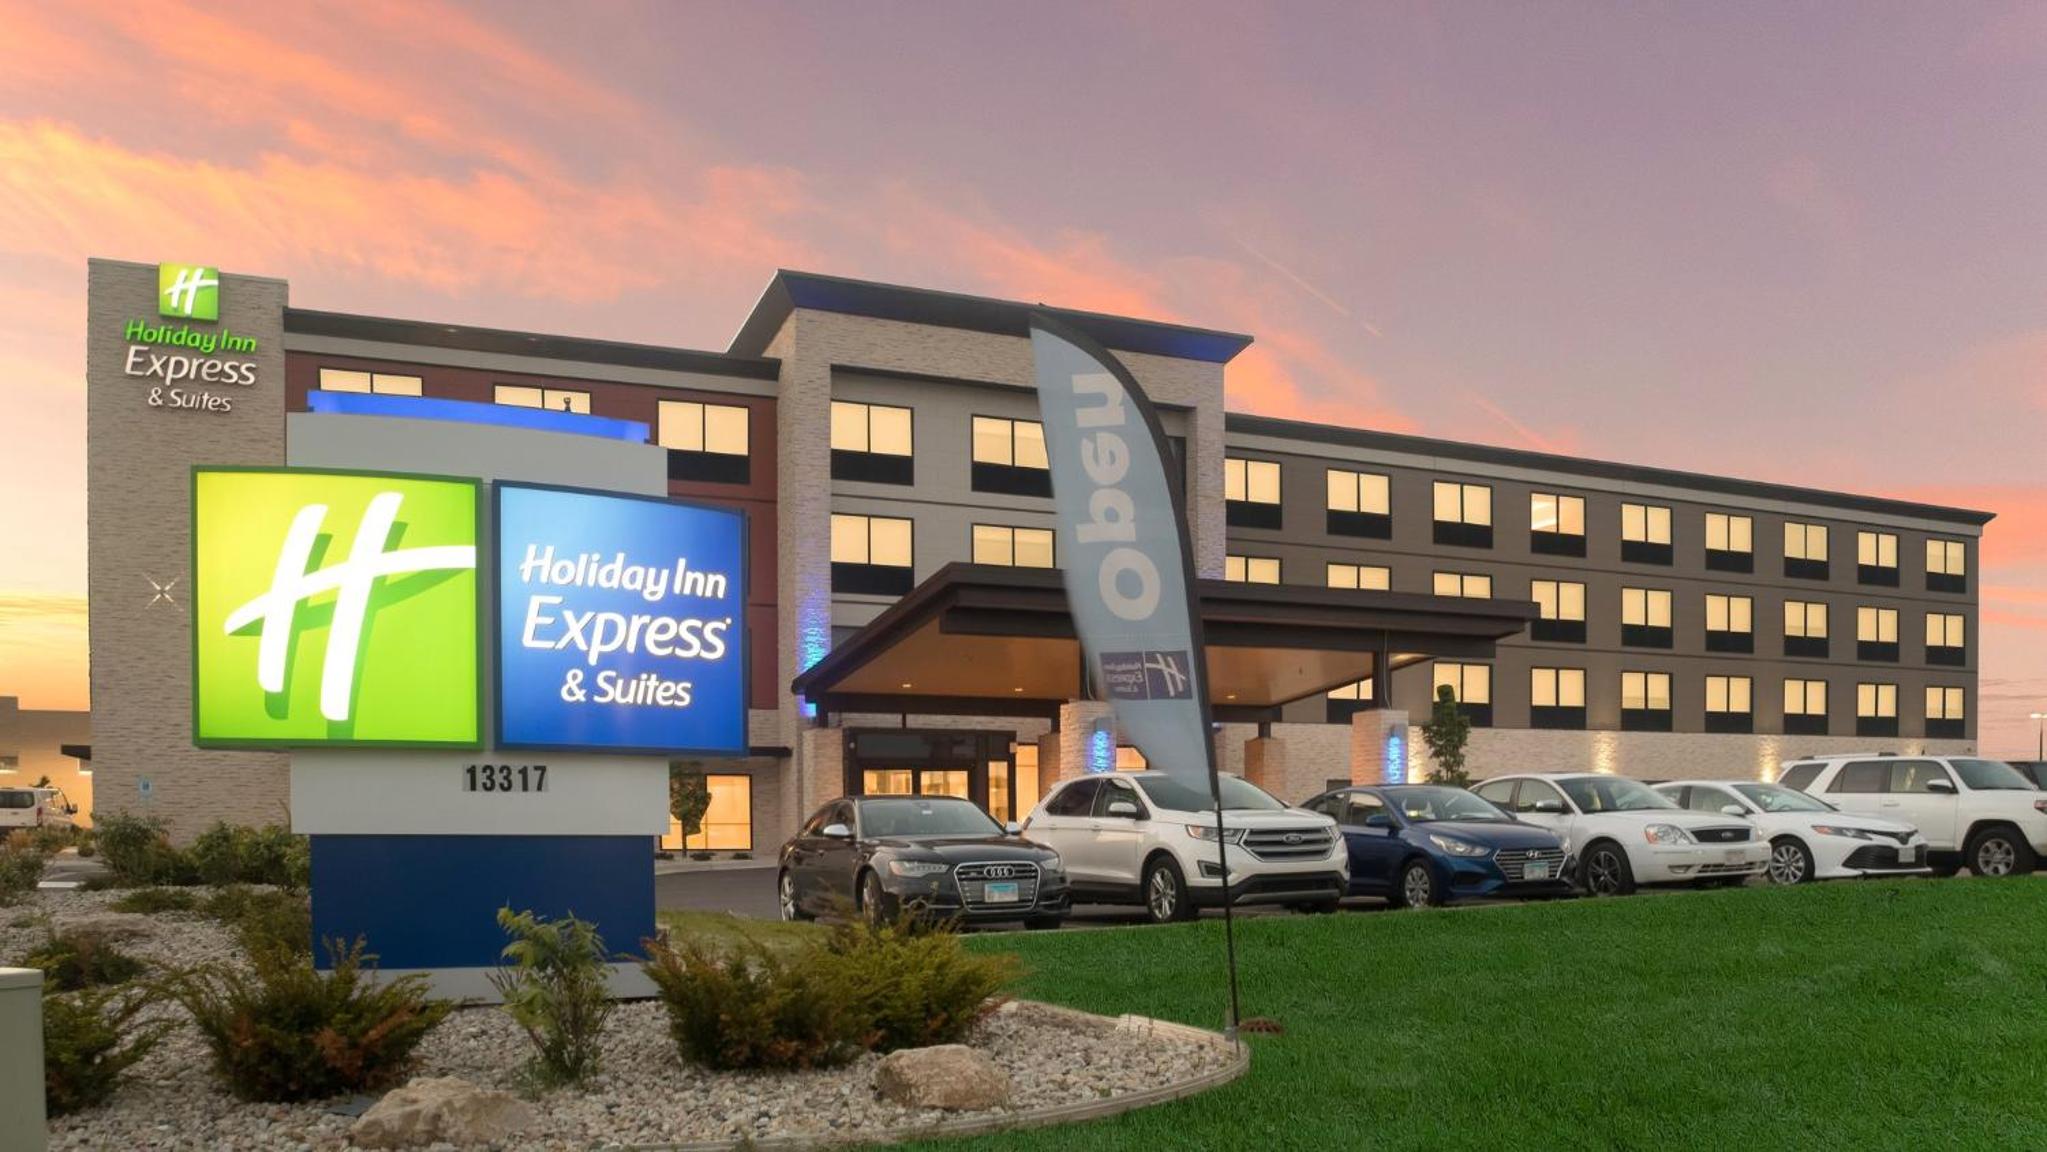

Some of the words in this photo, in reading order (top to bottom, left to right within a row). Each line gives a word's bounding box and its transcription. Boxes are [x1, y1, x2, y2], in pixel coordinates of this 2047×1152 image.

[125, 319, 217, 353] Holiday
[220, 328, 257, 352] Inn
[125, 345, 257, 386] Express
[148, 386, 163, 406] &
[168, 388, 233, 412] Suites
[519, 543, 669, 601] Holiday
[673, 557, 727, 599] Inn
[522, 594, 727, 666] Express
[560, 668, 587, 702] &
[593, 670, 692, 707] Suites
[466, 764, 547, 792] 13317
